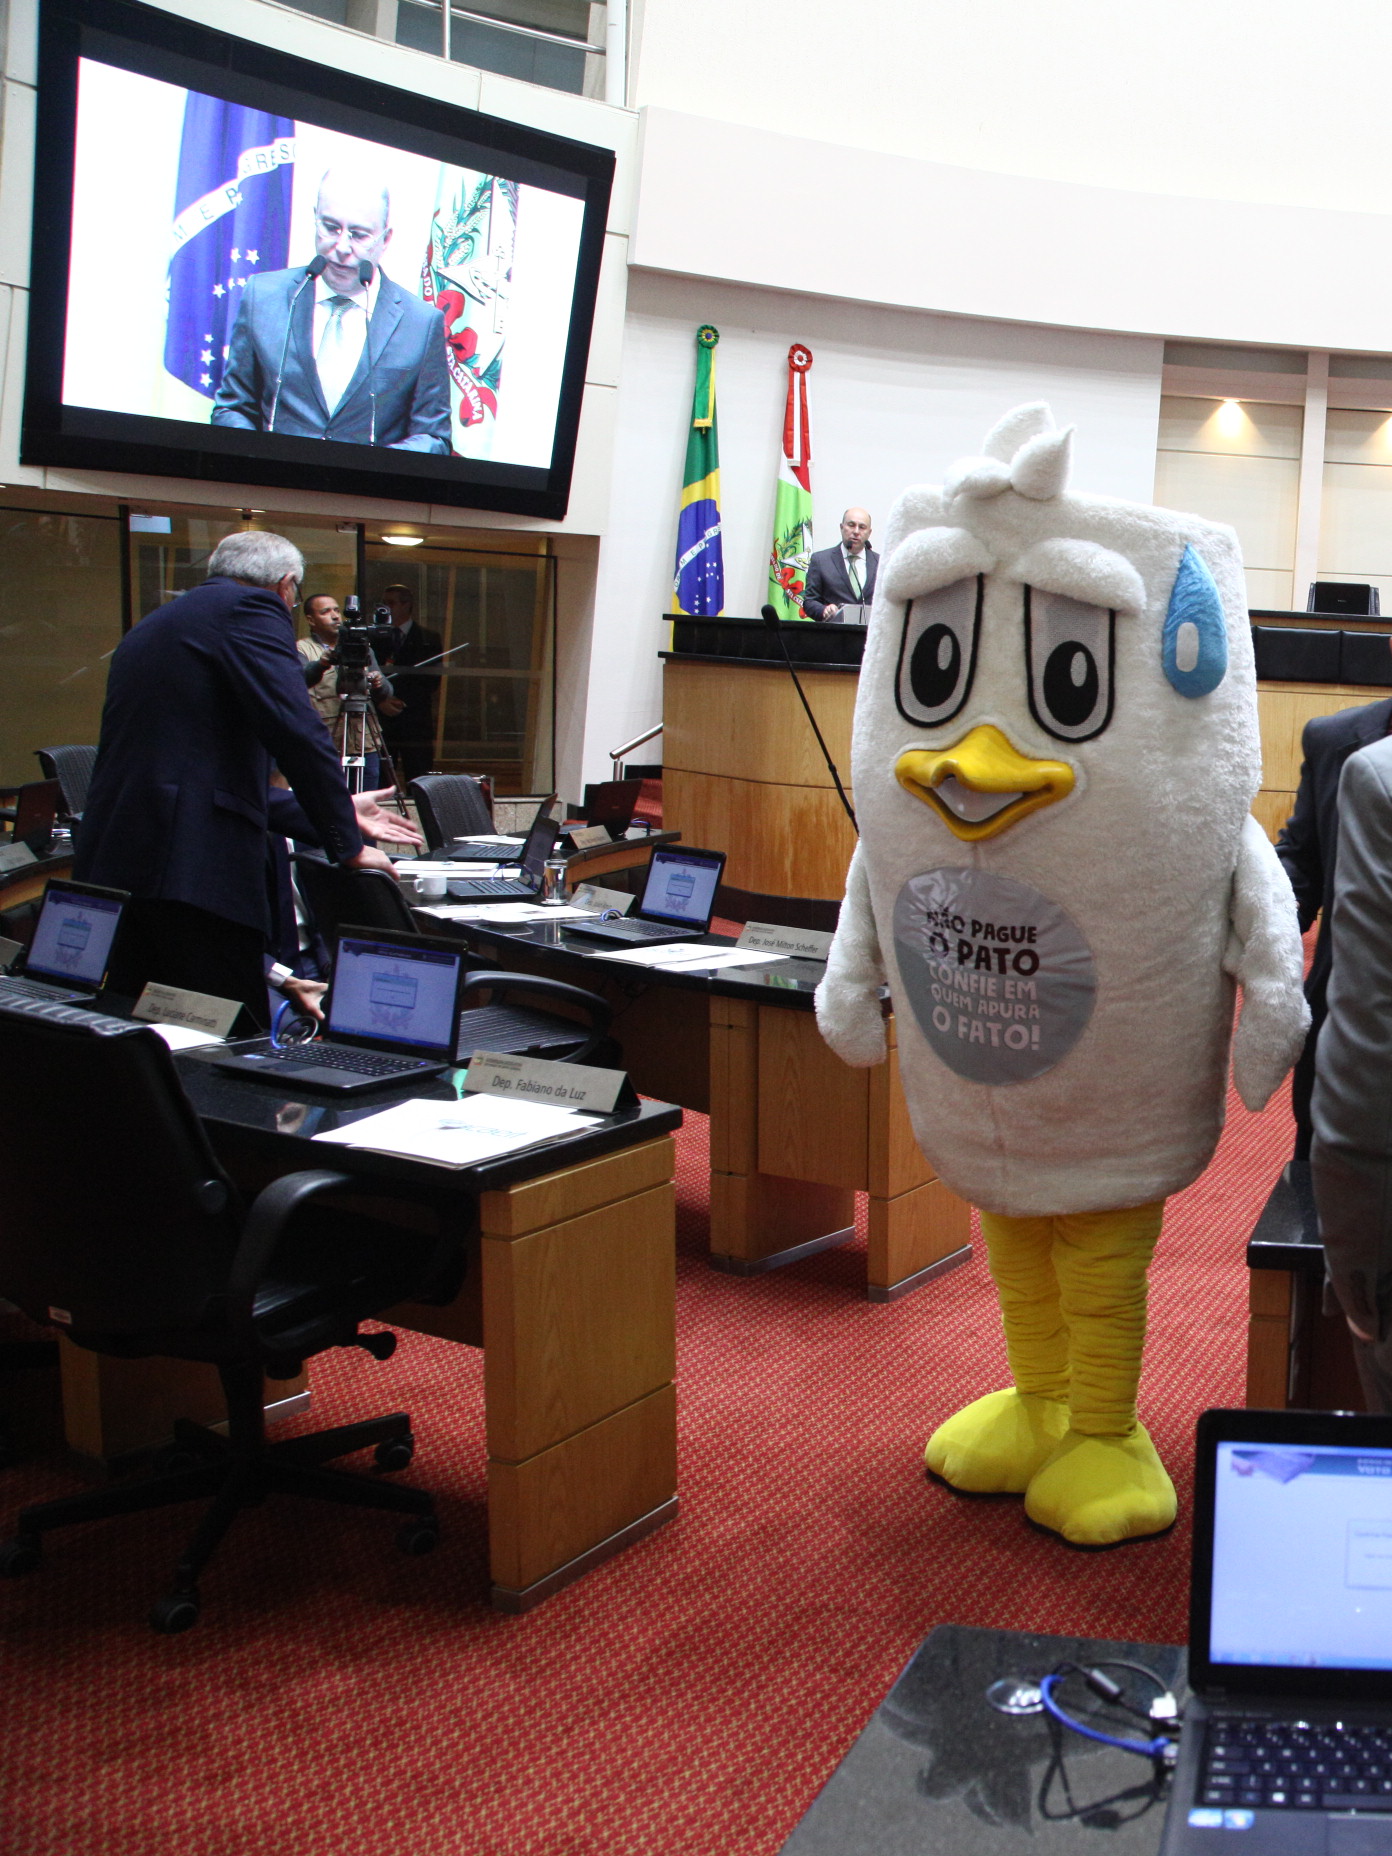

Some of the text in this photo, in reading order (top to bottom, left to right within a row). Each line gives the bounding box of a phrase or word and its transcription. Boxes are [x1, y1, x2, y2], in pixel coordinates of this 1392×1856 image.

[927, 906, 1038, 944] NÃO PAGUE
[929, 932, 1040, 977] O PATO
[930, 961, 1038, 1001] CONFIE EM
[931, 983, 1040, 1020] QUEM APURA
[932, 1006, 1040, 1051] O FATO!
[491, 1075, 588, 1101] Dep. Fabiano da Luz
